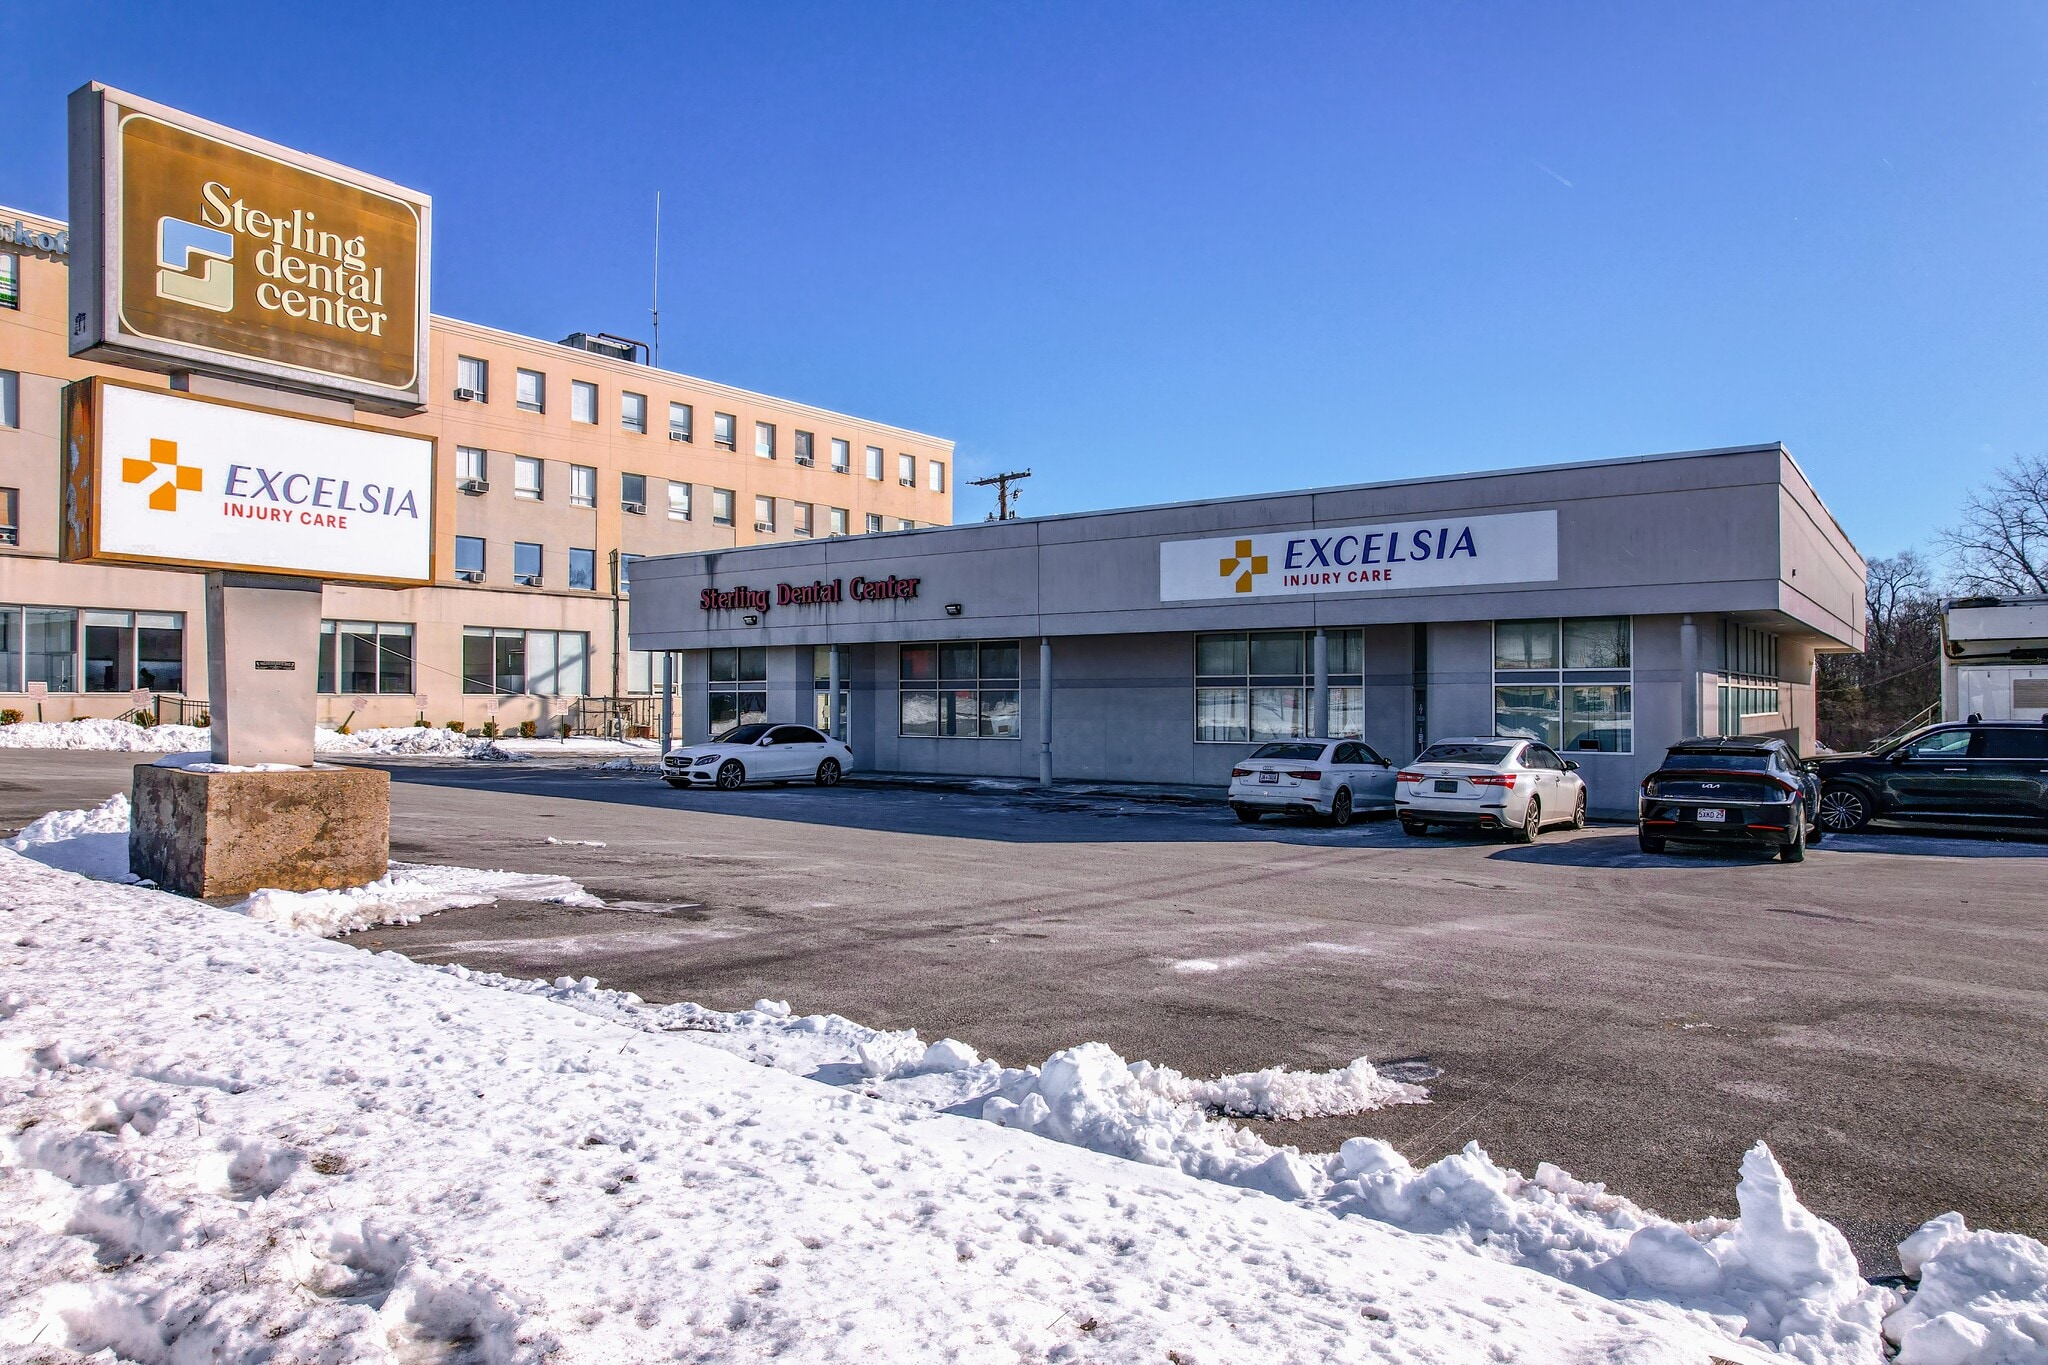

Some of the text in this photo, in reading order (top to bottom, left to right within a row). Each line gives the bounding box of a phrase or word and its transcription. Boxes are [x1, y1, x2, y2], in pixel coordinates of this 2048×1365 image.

[201, 181, 366, 272] Sterling
[255, 244, 383, 306] dental
[256, 282, 388, 336] center
[224, 464, 418, 519] EXCELSIA
[224, 502, 348, 529] INJURY CARE
[1284, 526, 1477, 569] EXCELSIA
[700, 575, 920, 612] Sterling Dental Center
[1284, 569, 1392, 586] INJURY CARE
